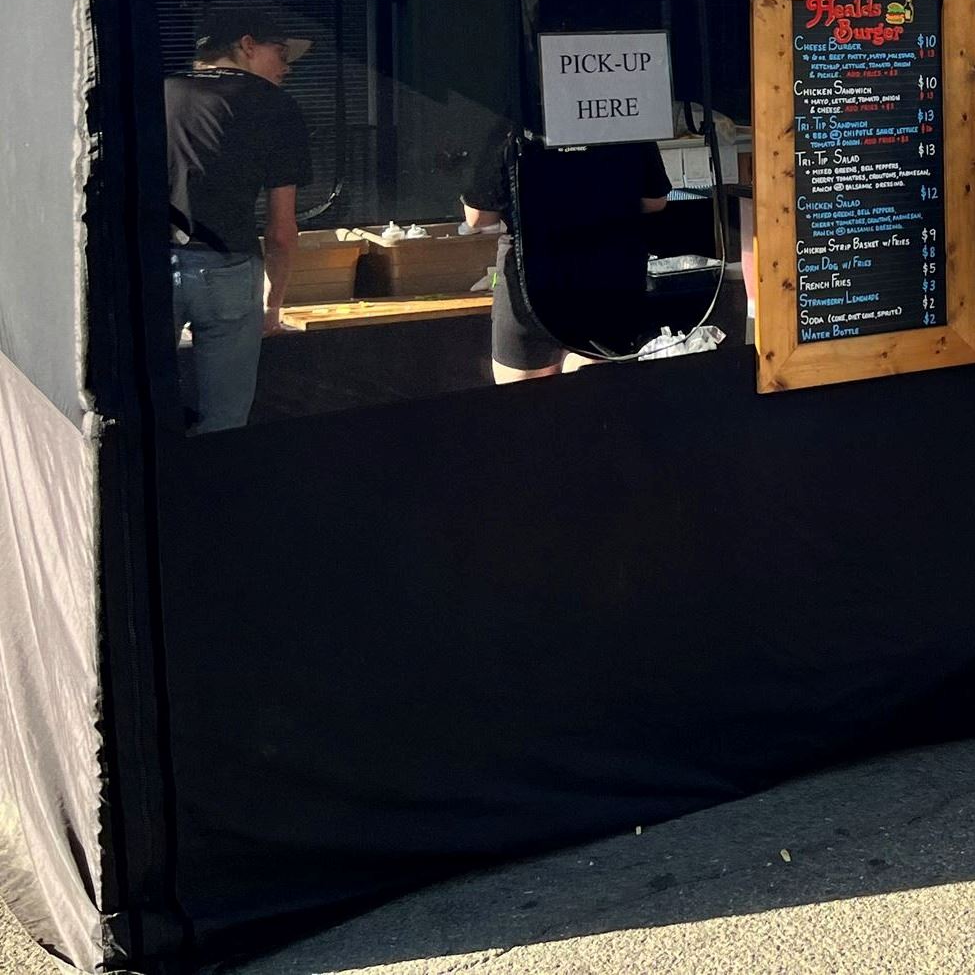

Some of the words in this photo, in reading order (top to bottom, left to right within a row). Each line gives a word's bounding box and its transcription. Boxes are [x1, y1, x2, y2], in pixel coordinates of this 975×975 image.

[834, 19, 904, 45] Burger
[917, 33, 936, 48] $10
[560, 52, 651, 74] PICK-UP
[918, 74, 937, 91] $10
[576, 97, 640, 120] HERE
[917, 108, 934, 123] $13
[918, 142, 935, 158] $13
[921, 185, 938, 201] $12
